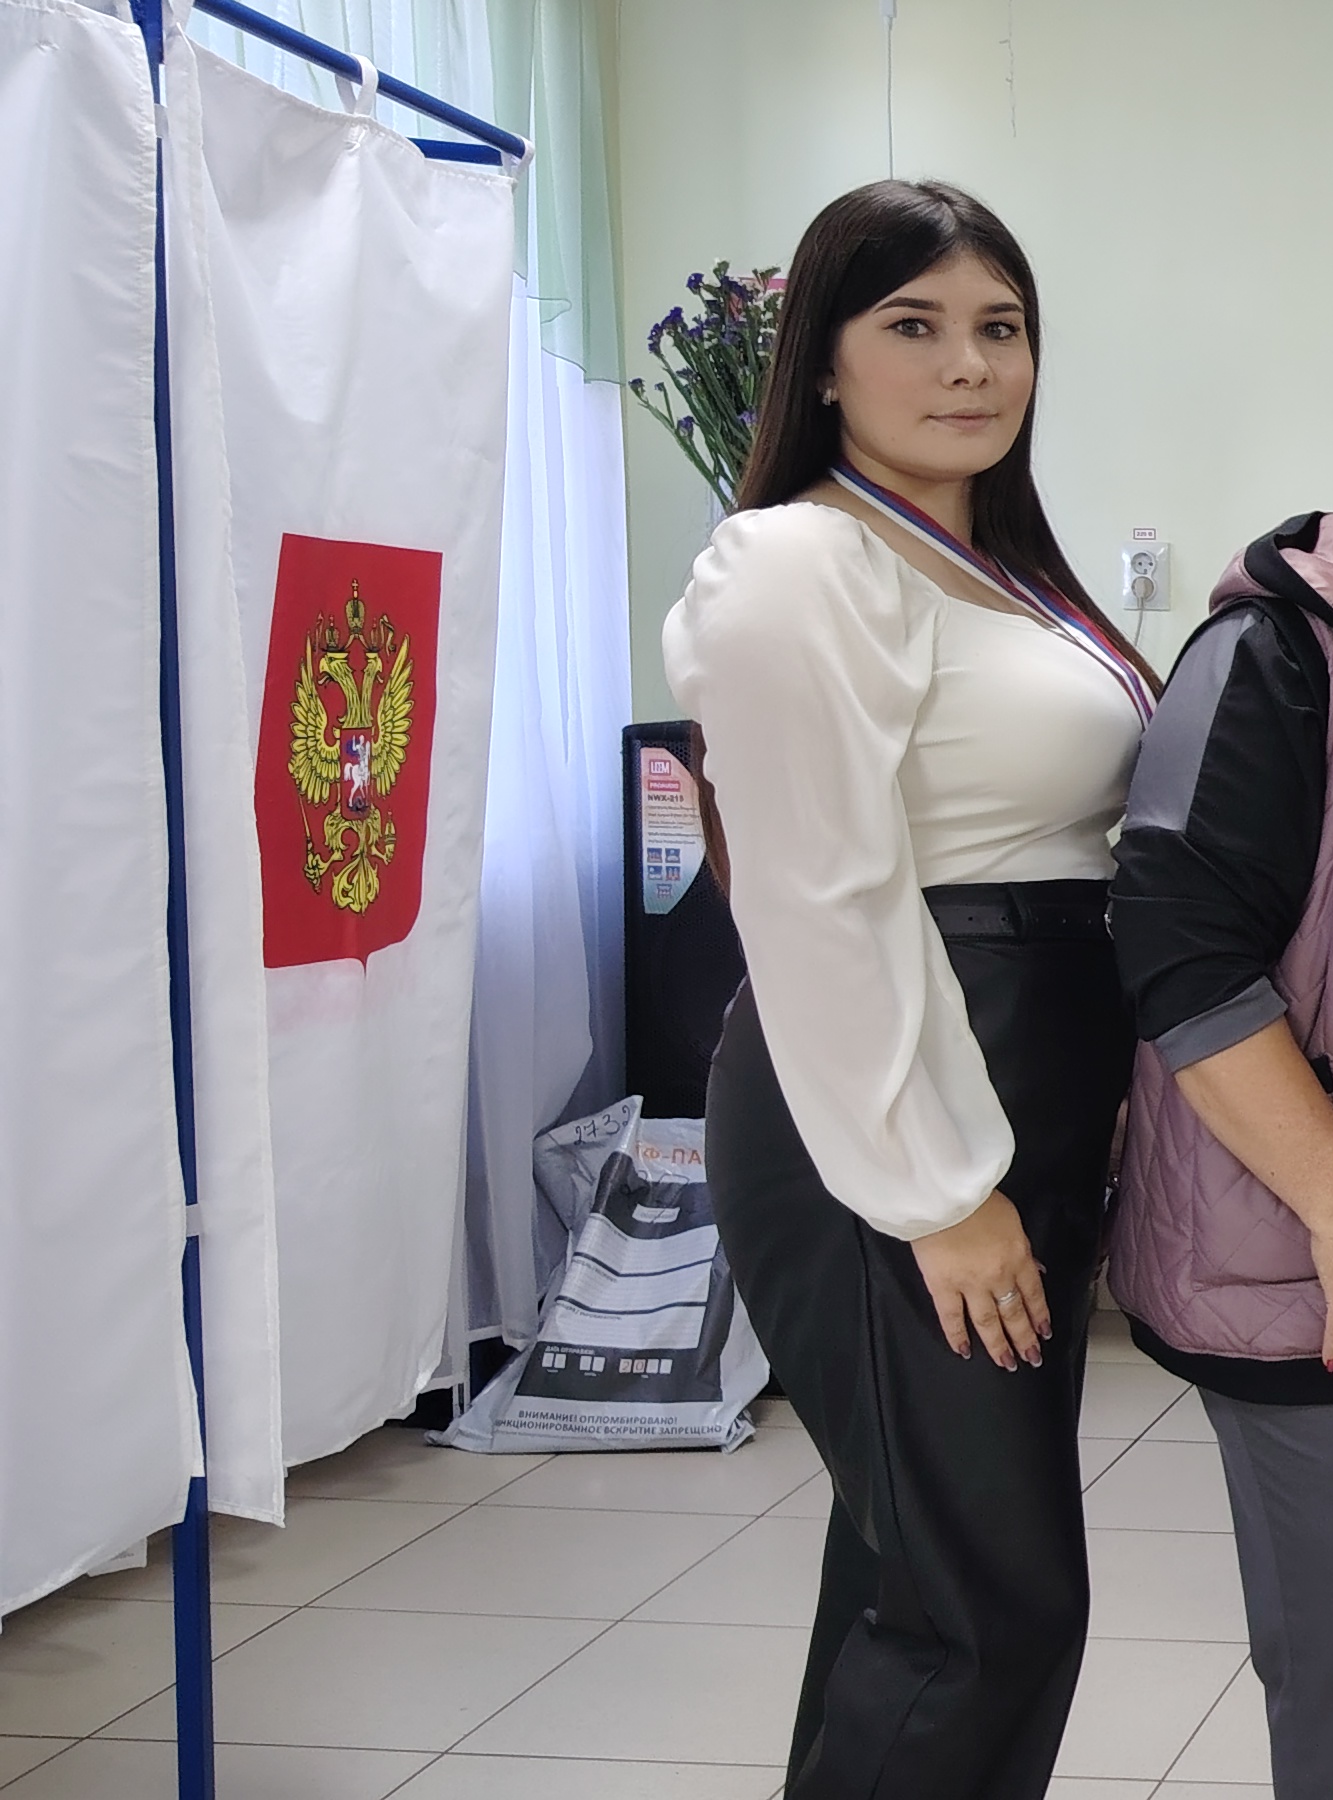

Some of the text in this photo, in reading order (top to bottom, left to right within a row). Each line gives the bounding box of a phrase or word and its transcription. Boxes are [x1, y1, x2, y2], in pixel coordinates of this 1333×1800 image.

[573, 1105, 631, 1146] 2732
[518, 1410, 677, 1425] ВНИМАНИЕ! ОПЛОМБИРОВАНО!
[604, 1425, 656, 1435] ВСКРЫТИЕ
